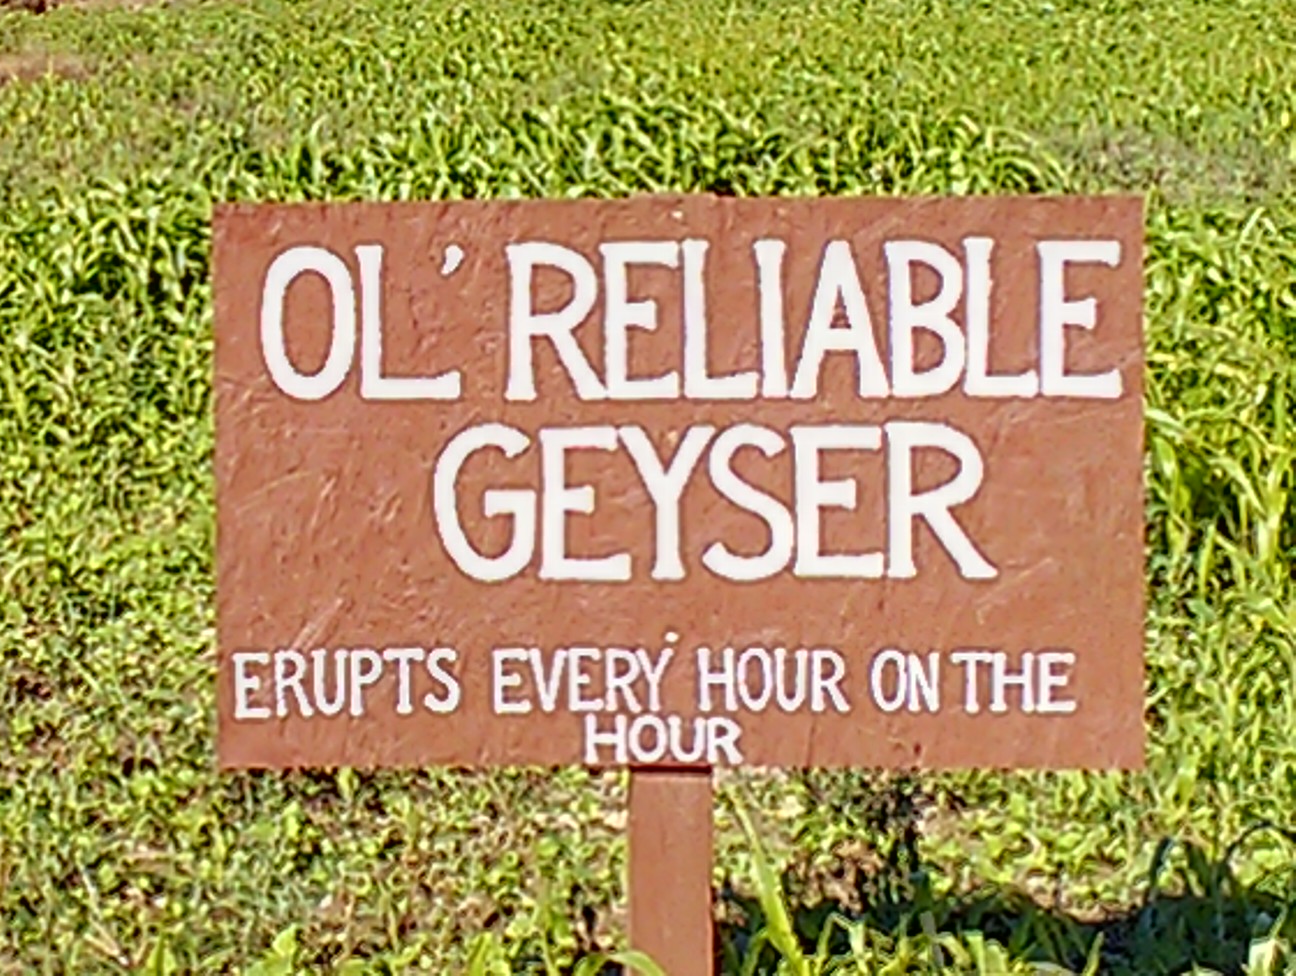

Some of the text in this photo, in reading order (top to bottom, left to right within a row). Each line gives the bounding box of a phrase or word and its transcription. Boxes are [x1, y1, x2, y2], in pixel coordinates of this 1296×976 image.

[505, 237, 1122, 400] RELIABLE
[433, 422, 998, 582] GEYSER
[232, 645, 1078, 719] ERUPTS EVERY HOUR ON THE
[584, 715, 743, 765] HOUR
